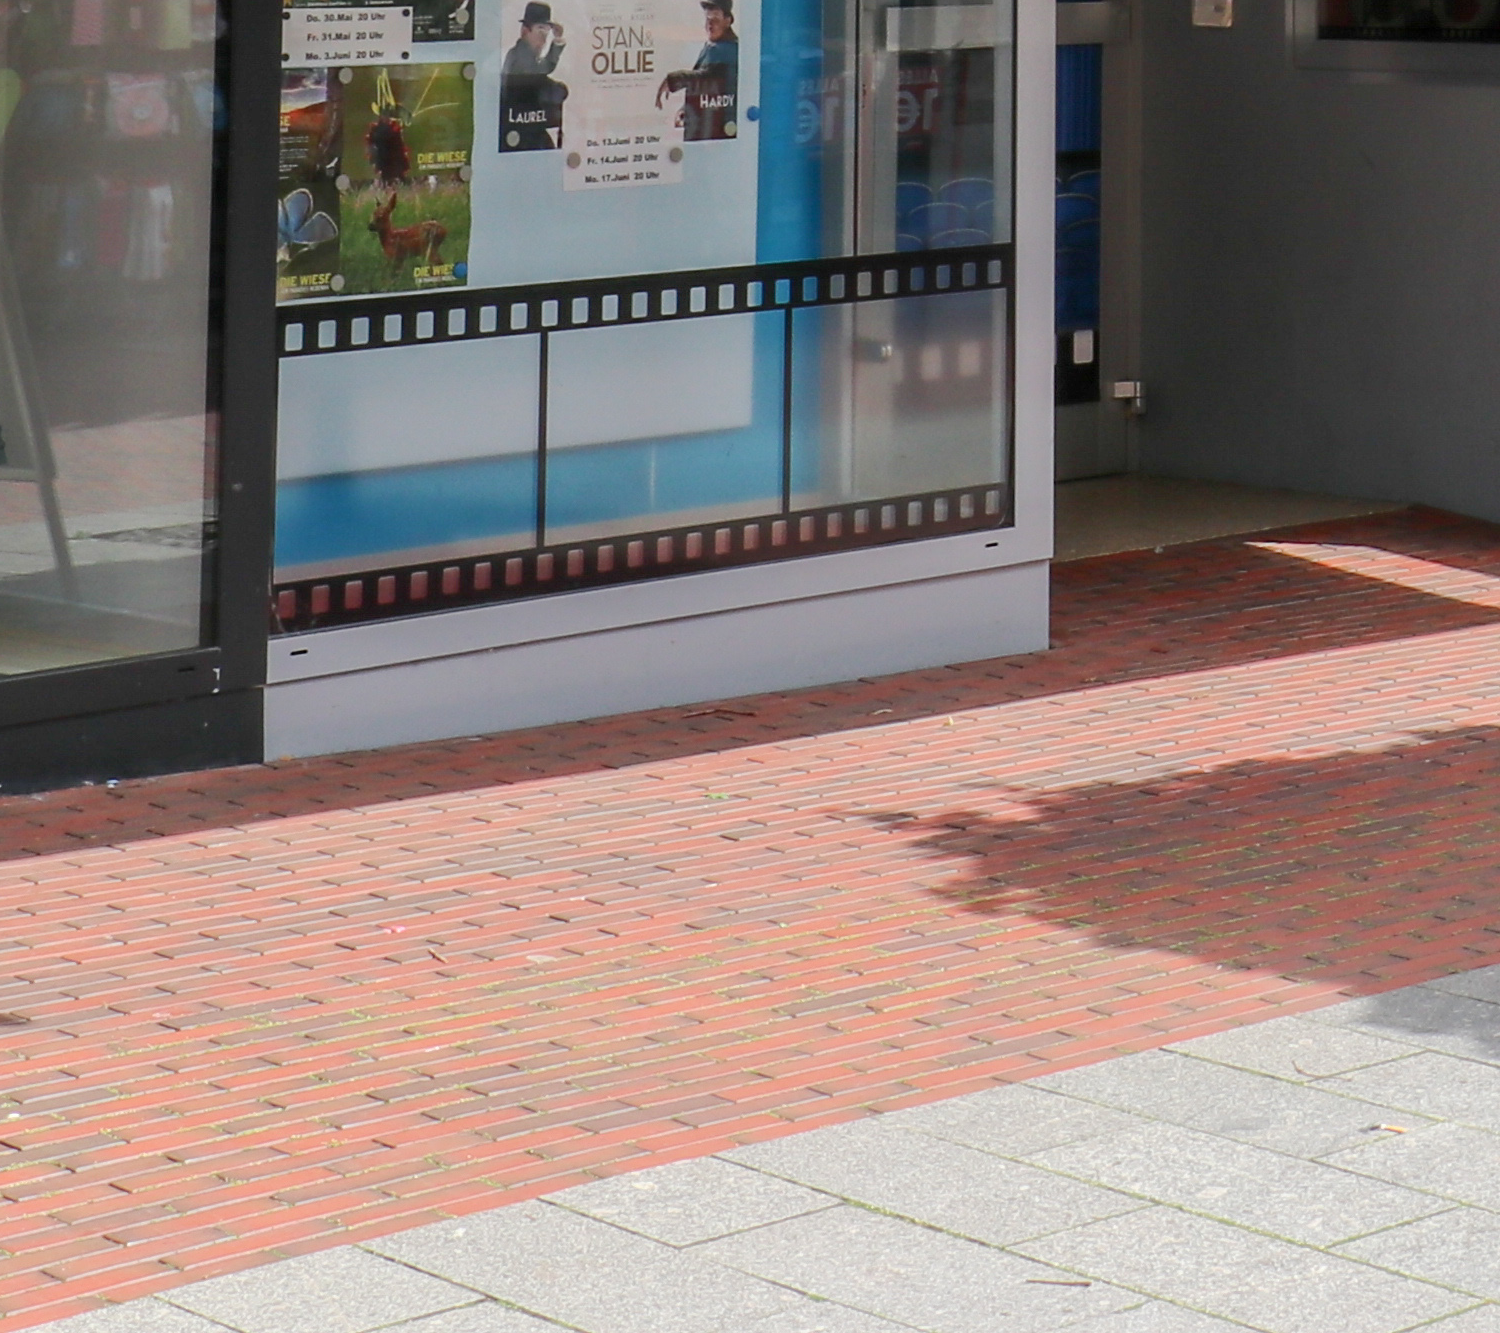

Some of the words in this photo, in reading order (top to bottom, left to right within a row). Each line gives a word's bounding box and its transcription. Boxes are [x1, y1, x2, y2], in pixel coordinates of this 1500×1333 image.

[307, 14, 321, 23] Do.
[324, 13, 353, 22] 30.Mai
[371, 13, 385, 21] Uhr
[321, 32, 351, 41] 31.Mai
[356, 32, 366, 40] 20
[369, 32, 383, 40] Uhr
[592, 25, 643, 50] STAN
[356, 51, 366, 59] 20
[592, 50, 654, 75] OLLIE
[700, 93, 735, 109] HARDY
[509, 107, 547, 124] LAUREL
[635, 137, 645, 145] 20
[417, 153, 434, 163] DIE
[437, 150, 467, 162] WIESE
[633, 154, 643, 162] 20
[634, 172, 644, 180] 20
[414, 266, 431, 277] DIE
